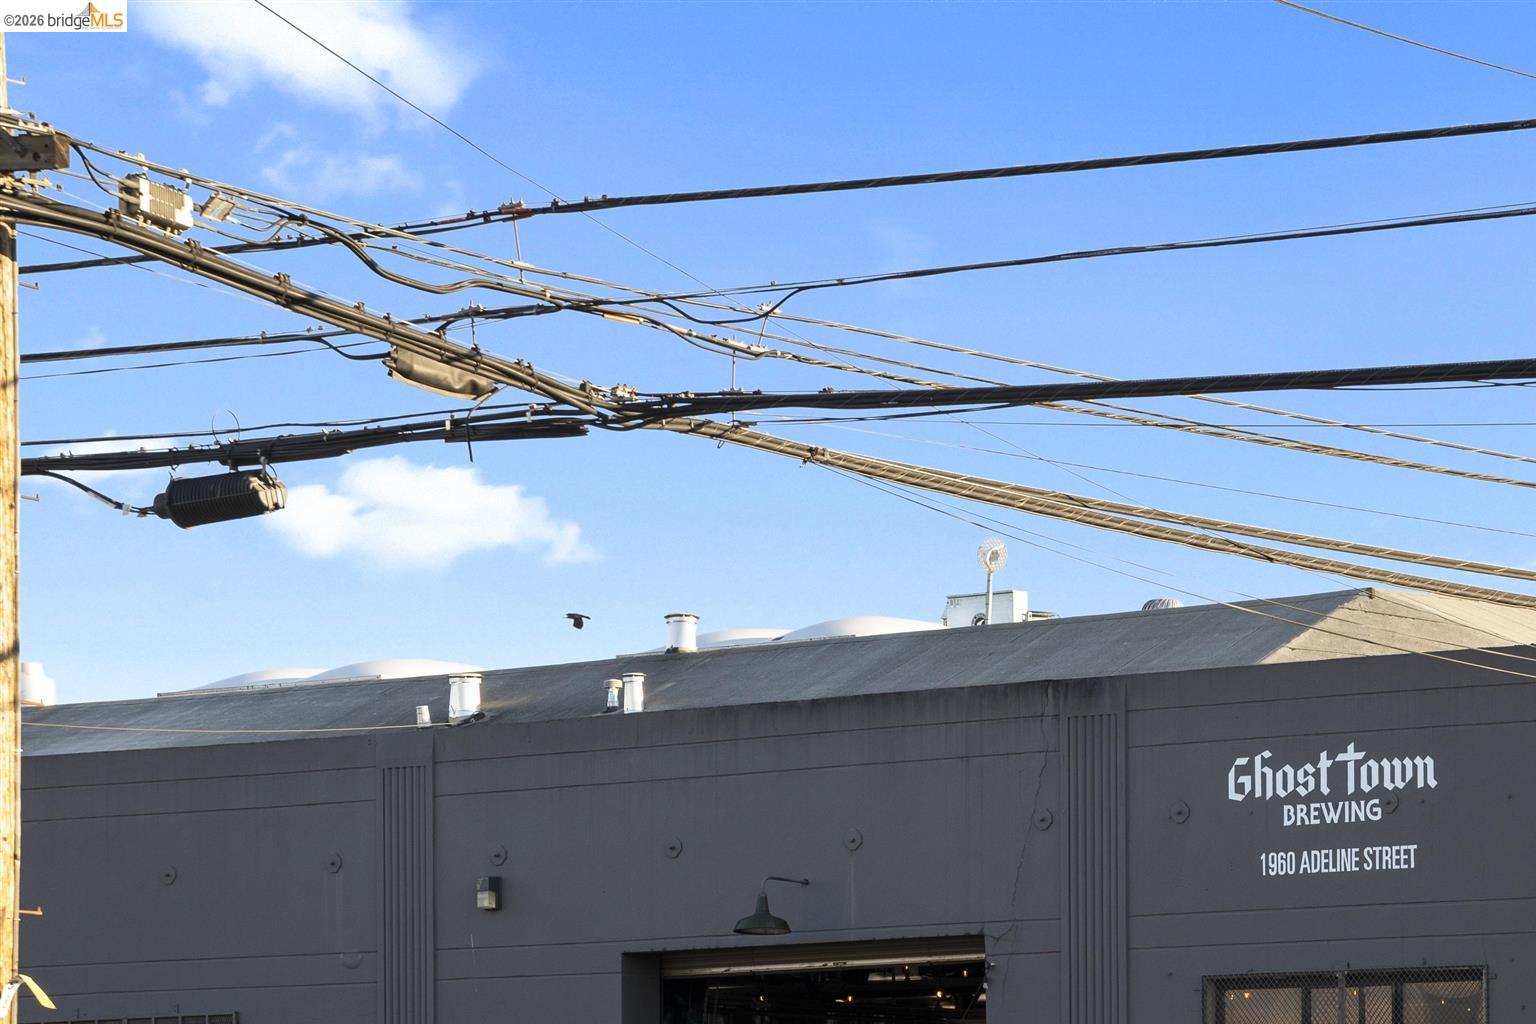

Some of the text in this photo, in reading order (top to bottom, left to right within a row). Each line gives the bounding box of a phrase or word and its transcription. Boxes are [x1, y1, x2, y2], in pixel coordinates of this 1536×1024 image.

[1228, 742, 1438, 802] Ghost Town
[1283, 799, 1382, 827] BREWING
[1260, 844, 1418, 876] 1960 ADELINE STREET
